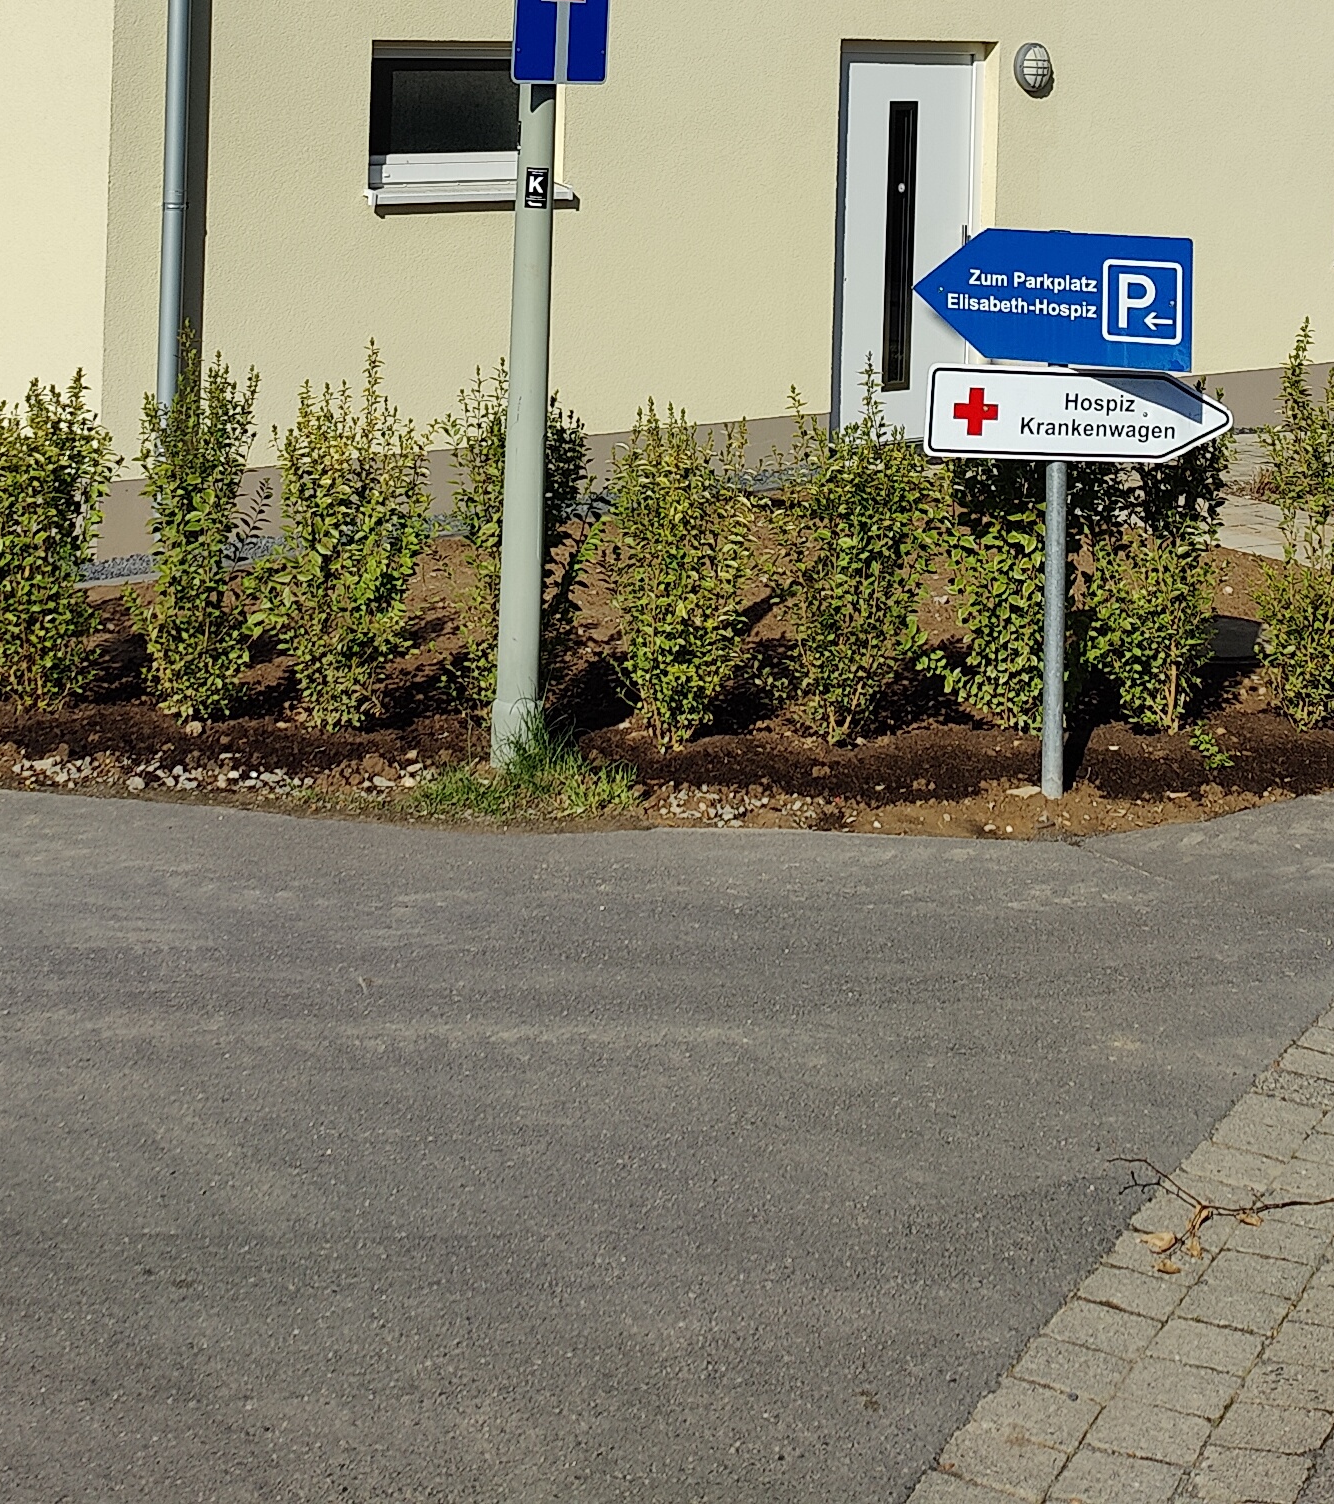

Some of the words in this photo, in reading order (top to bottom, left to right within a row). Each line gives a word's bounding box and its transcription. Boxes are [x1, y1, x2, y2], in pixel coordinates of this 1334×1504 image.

[528, 176, 544, 193] K
[968, 269, 1008, 287] Zum
[1013, 271, 1098, 294] Parkplatz
[947, 293, 1098, 320] Elisabeth-Hospiz
[1118, 273, 1156, 329] P
[1064, 392, 1136, 417] Hospiz
[1020, 416, 1176, 443] Krankenwagen
